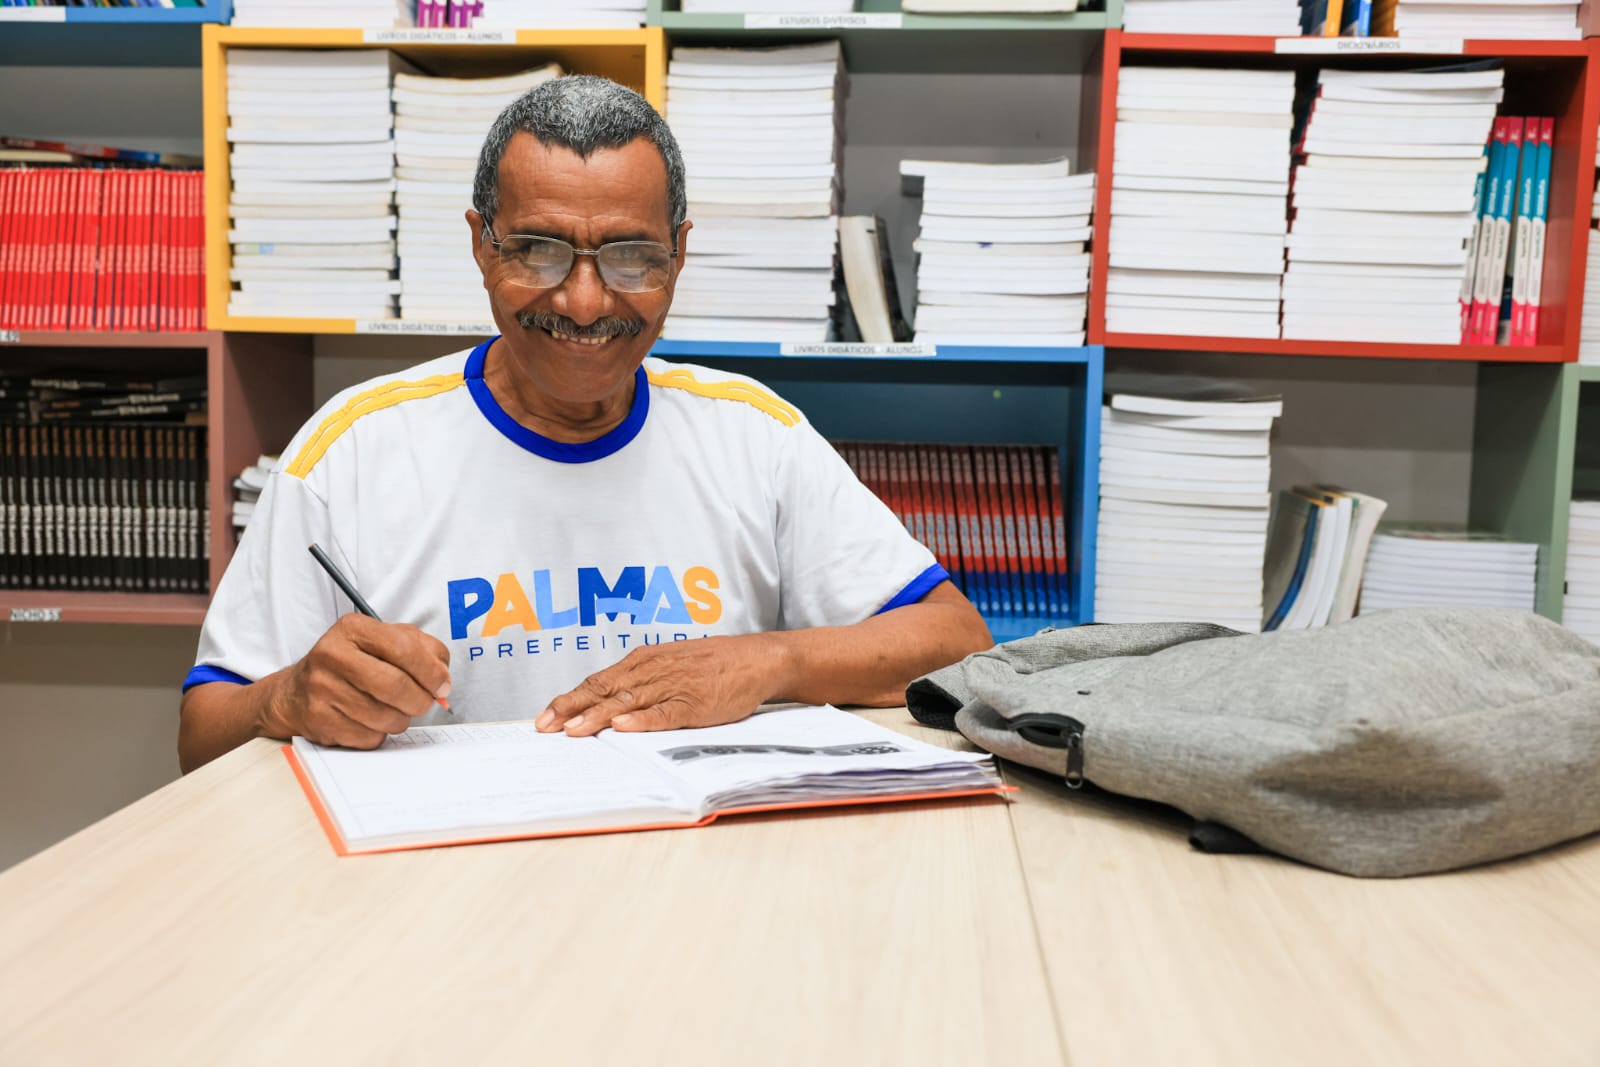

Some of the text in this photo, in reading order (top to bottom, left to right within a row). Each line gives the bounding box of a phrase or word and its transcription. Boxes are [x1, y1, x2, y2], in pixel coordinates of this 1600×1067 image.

[779, 15, 866, 25] ESTUDOS DIVERSOS
[376, 31, 407, 41] LIVROS
[467, 31, 503, 41] ALUNOS
[367, 322, 399, 332] LIVROS
[456, 323, 493, 333] ALUNOS
[793, 344, 825, 354] LIVROS
[447, 565, 723, 641] PALMAS
[469, 633, 708, 661] PREFEITUR
